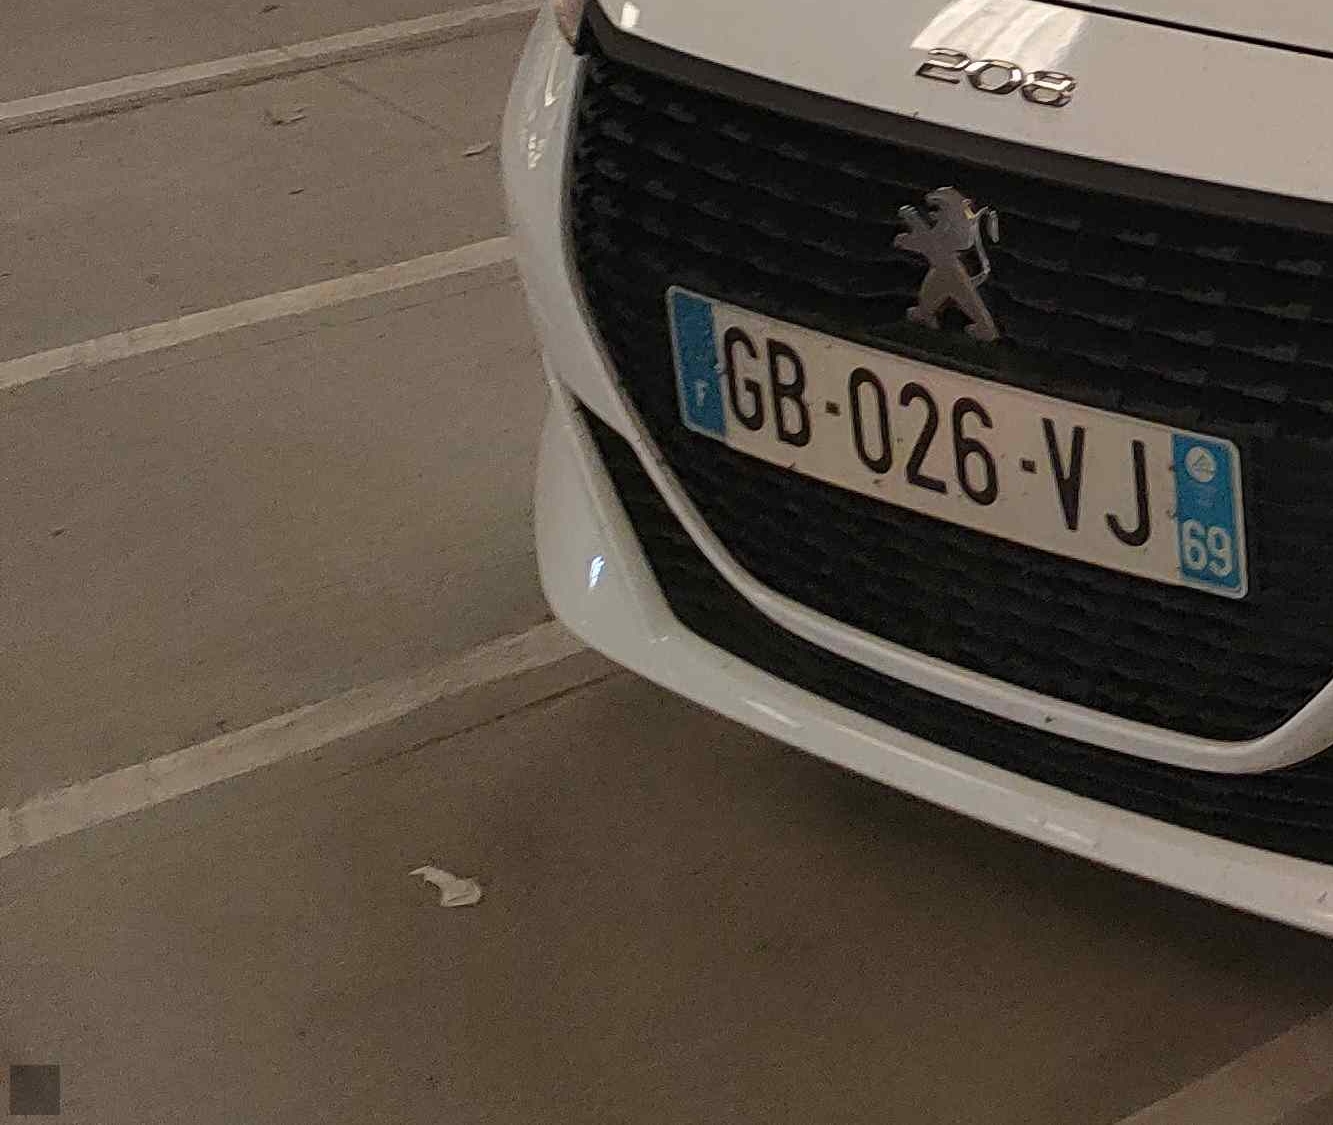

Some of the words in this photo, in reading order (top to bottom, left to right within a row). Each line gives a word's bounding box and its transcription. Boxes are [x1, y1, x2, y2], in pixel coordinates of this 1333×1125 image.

[914, 48, 1077, 108] 208
[724, 325, 1152, 548] GB-026-VJ
[1182, 518, 1233, 578] 69
